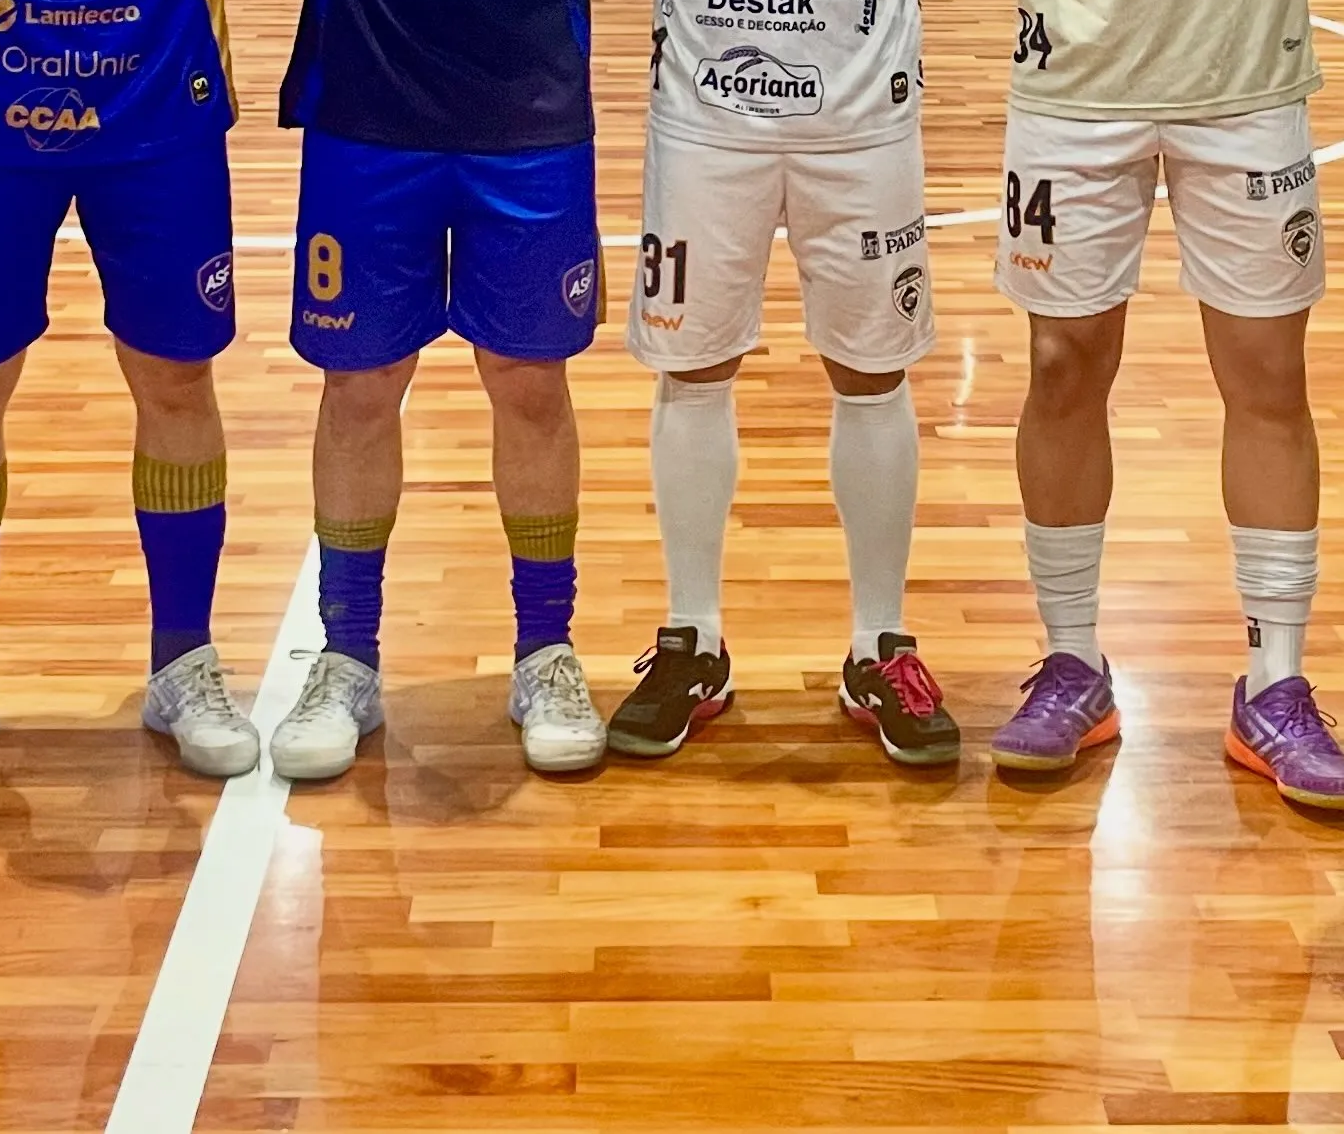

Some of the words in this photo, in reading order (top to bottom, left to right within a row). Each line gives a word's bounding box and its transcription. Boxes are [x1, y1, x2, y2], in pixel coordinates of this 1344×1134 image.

[24, 3, 141, 26] Lamiecco
[695, 14, 735, 28] GESSO
[736, 18, 745, 30] E
[747, 19, 827, 34] DECORAÇÃO
[700, 67, 817, 98] Açoriana
[4, 104, 101, 131] CCAA
[1006, 170, 1056, 245] 84
[308, 232, 342, 302] 8
[640, 233, 687, 304] 31
